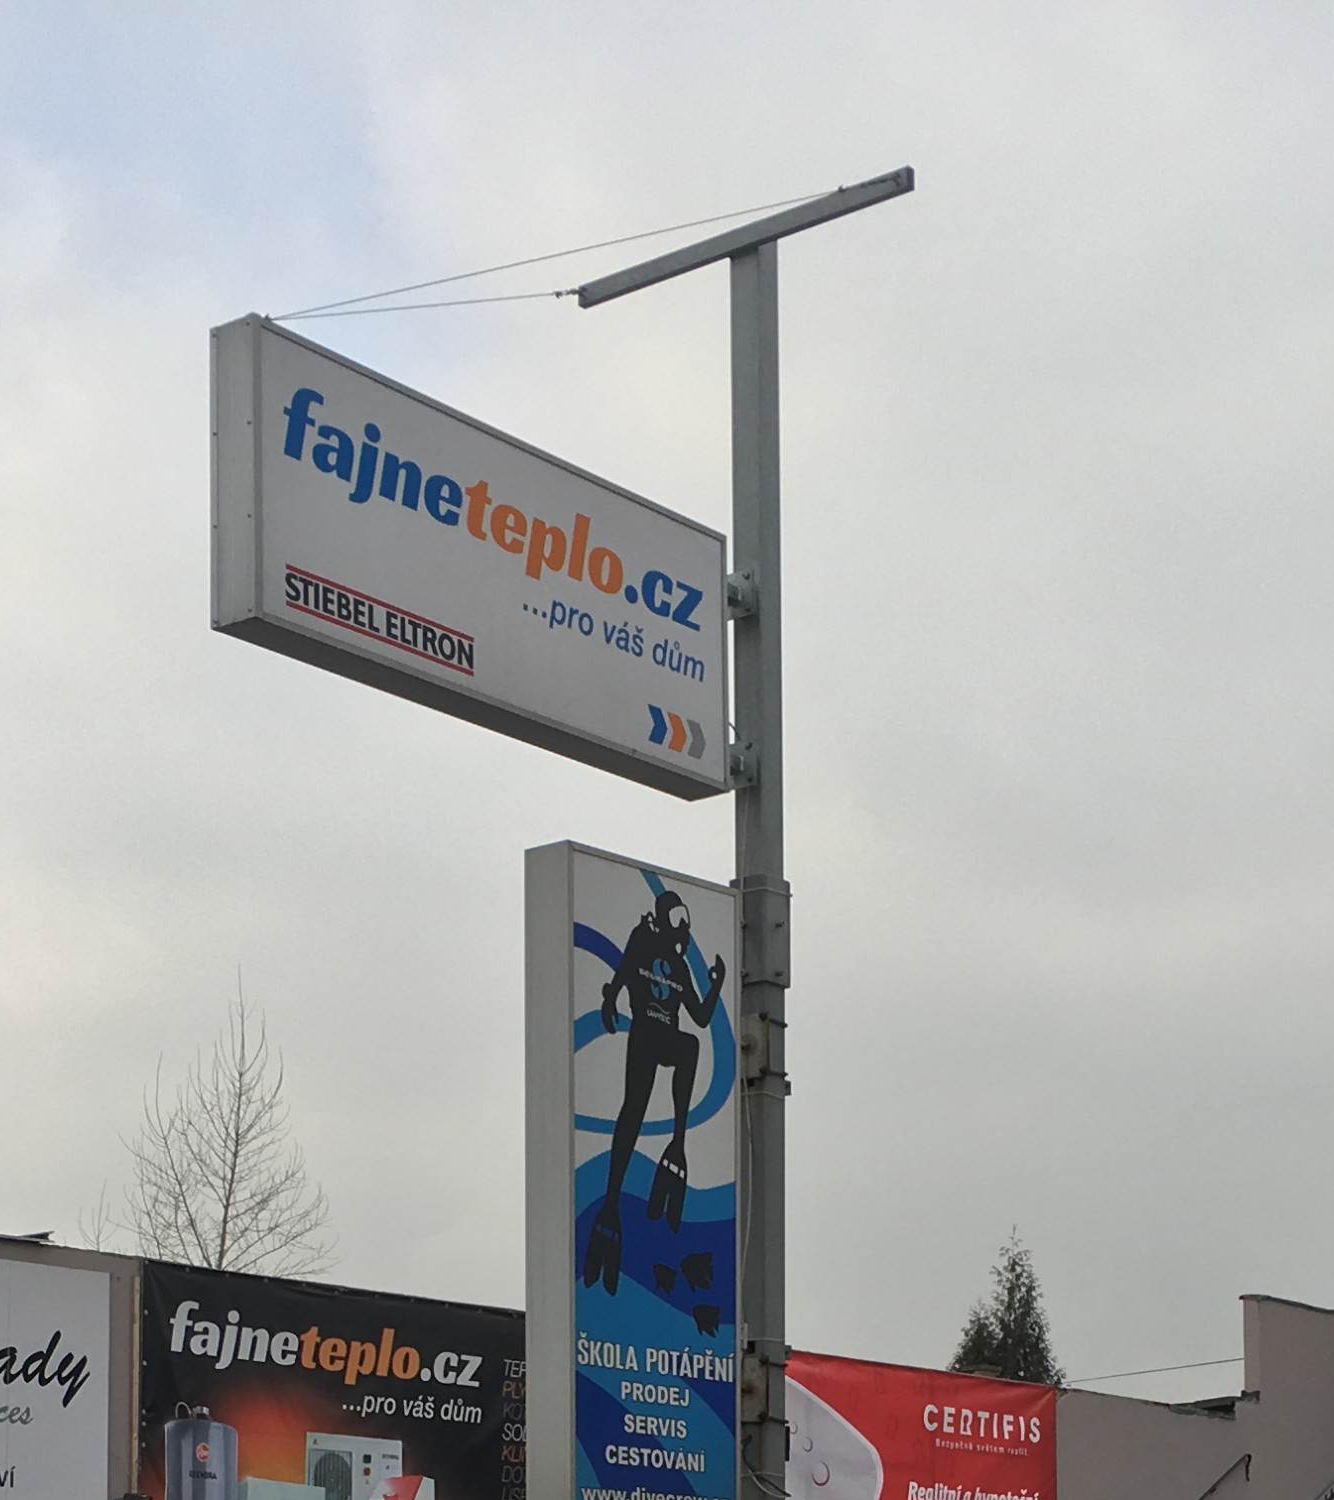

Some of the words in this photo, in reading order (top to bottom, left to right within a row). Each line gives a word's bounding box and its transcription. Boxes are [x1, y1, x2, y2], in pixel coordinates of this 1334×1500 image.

[283, 388, 703, 632] fajneteplo.cz
[285, 572, 380, 633] STIEBEL
[386, 610, 474, 669] ELTRON
[603, 618, 645, 656] váš
[652, 641, 705, 682] dům
[170, 1300, 483, 1388] fajneteplo.cz
[577, 1331, 638, 1371] ŠKOLA
[646, 1347, 734, 1383] POTÁPĚNÍ
[402, 1395, 435, 1420] váš
[440, 1398, 482, 1424] dům
[621, 1381, 690, 1407] PRODEJ
[624, 1414, 687, 1439] SERVIS
[923, 1404, 1041, 1444] CERTIFIS
[605, 1444, 705, 1473] CESTOVÁNÍ
